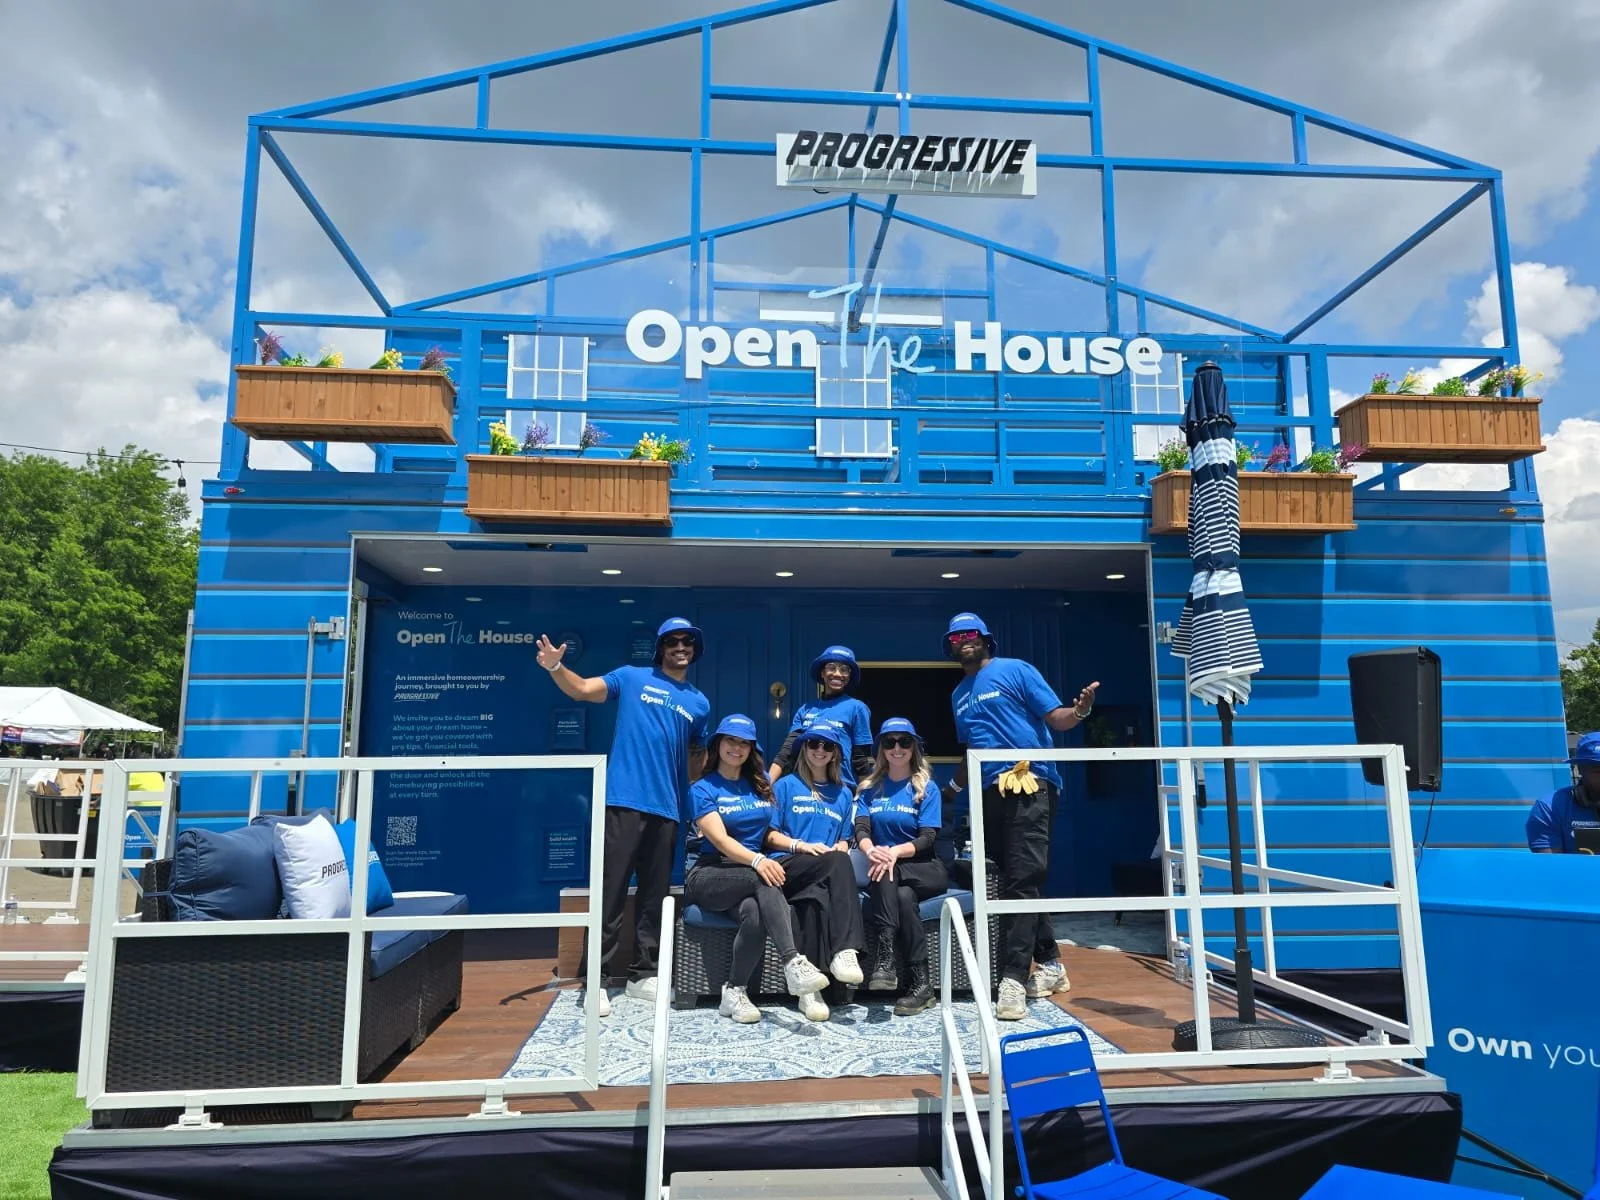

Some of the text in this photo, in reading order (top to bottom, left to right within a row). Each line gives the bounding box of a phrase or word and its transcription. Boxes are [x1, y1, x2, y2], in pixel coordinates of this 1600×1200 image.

[786, 131, 1032, 174] PROGRESSIVE
[625, 281, 1162, 379] Open The House
[398, 611, 442, 620] Welcome
[396, 620, 534, 647] Open The House
[446, 674, 505, 682] homeownership
[640, 693, 664, 705] Open
[978, 690, 1000, 702] House
[439, 781, 484, 789] possibilities
[718, 806, 742, 814] Open
[792, 806, 814, 814] Open
[1448, 1028, 1532, 1059] Own
